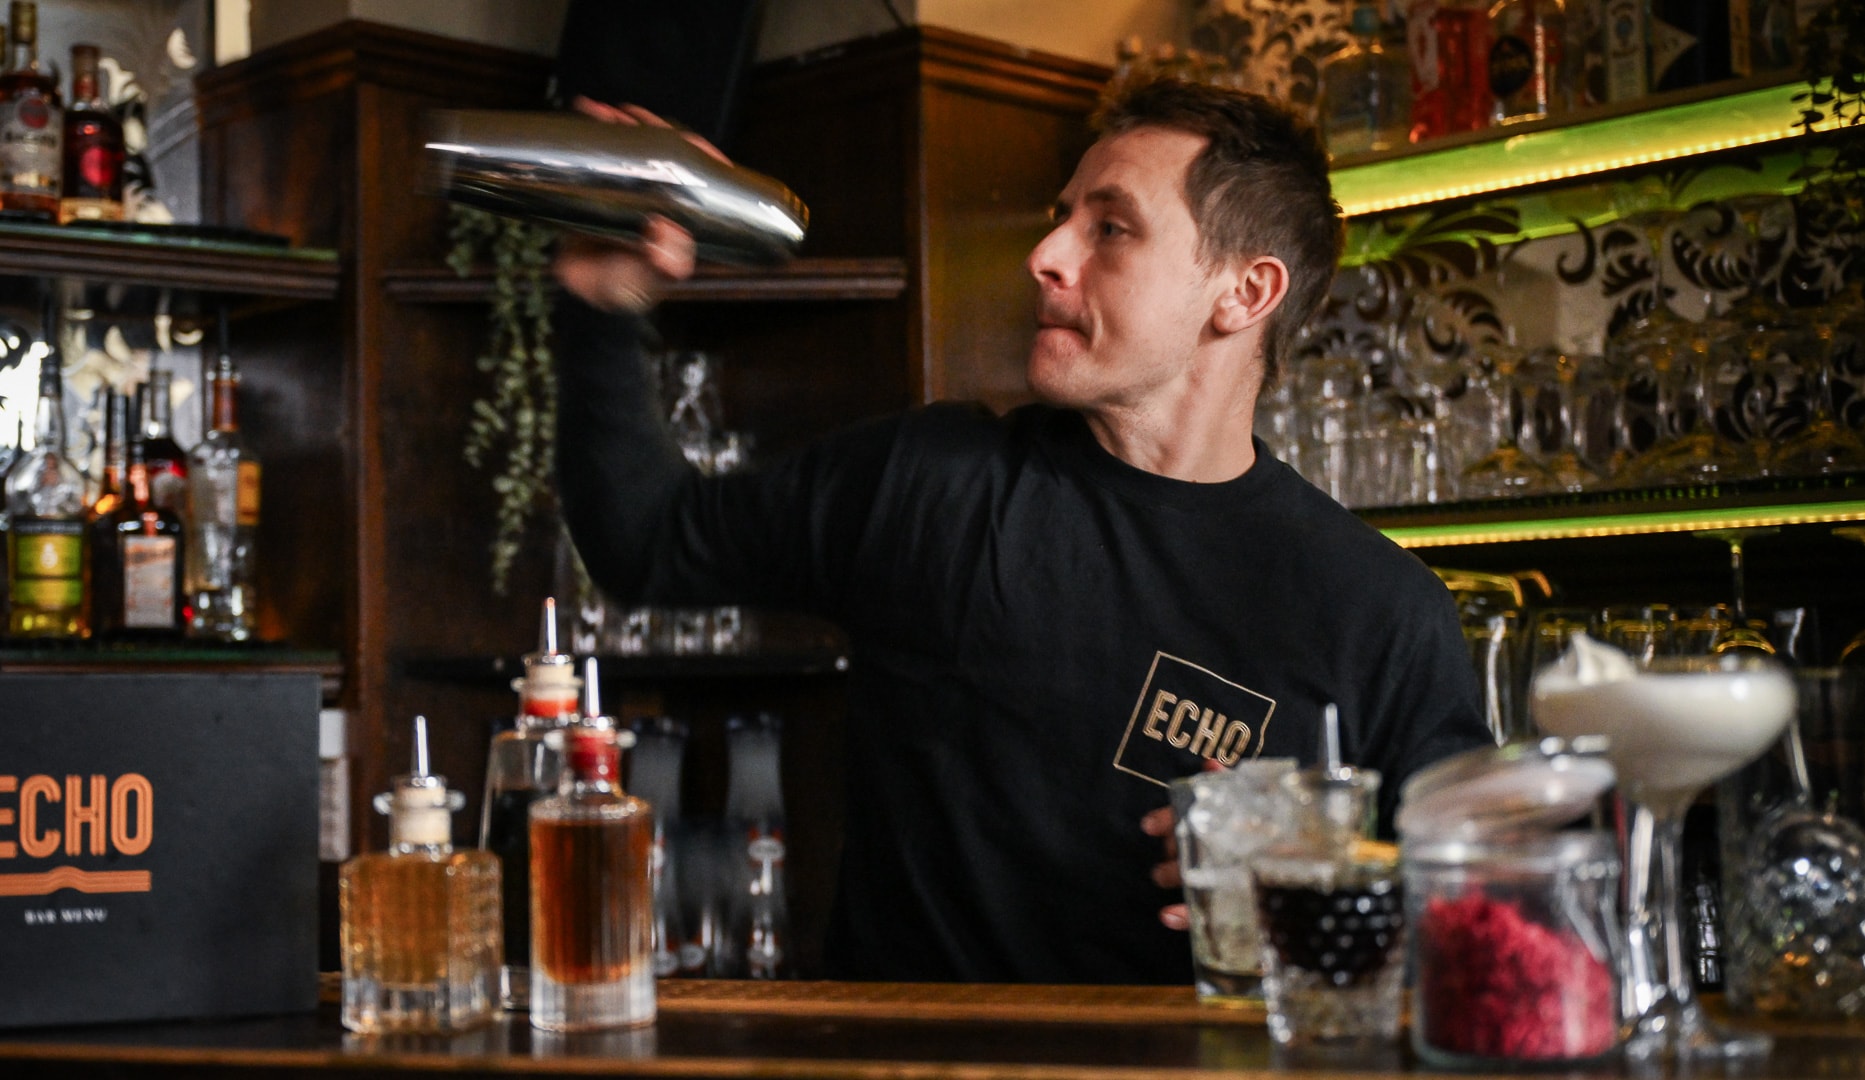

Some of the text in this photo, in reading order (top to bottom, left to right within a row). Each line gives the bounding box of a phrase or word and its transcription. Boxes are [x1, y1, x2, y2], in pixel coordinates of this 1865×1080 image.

[1142, 688, 1252, 767] ECHO
[24, 906, 108, 926] BAR MENU
